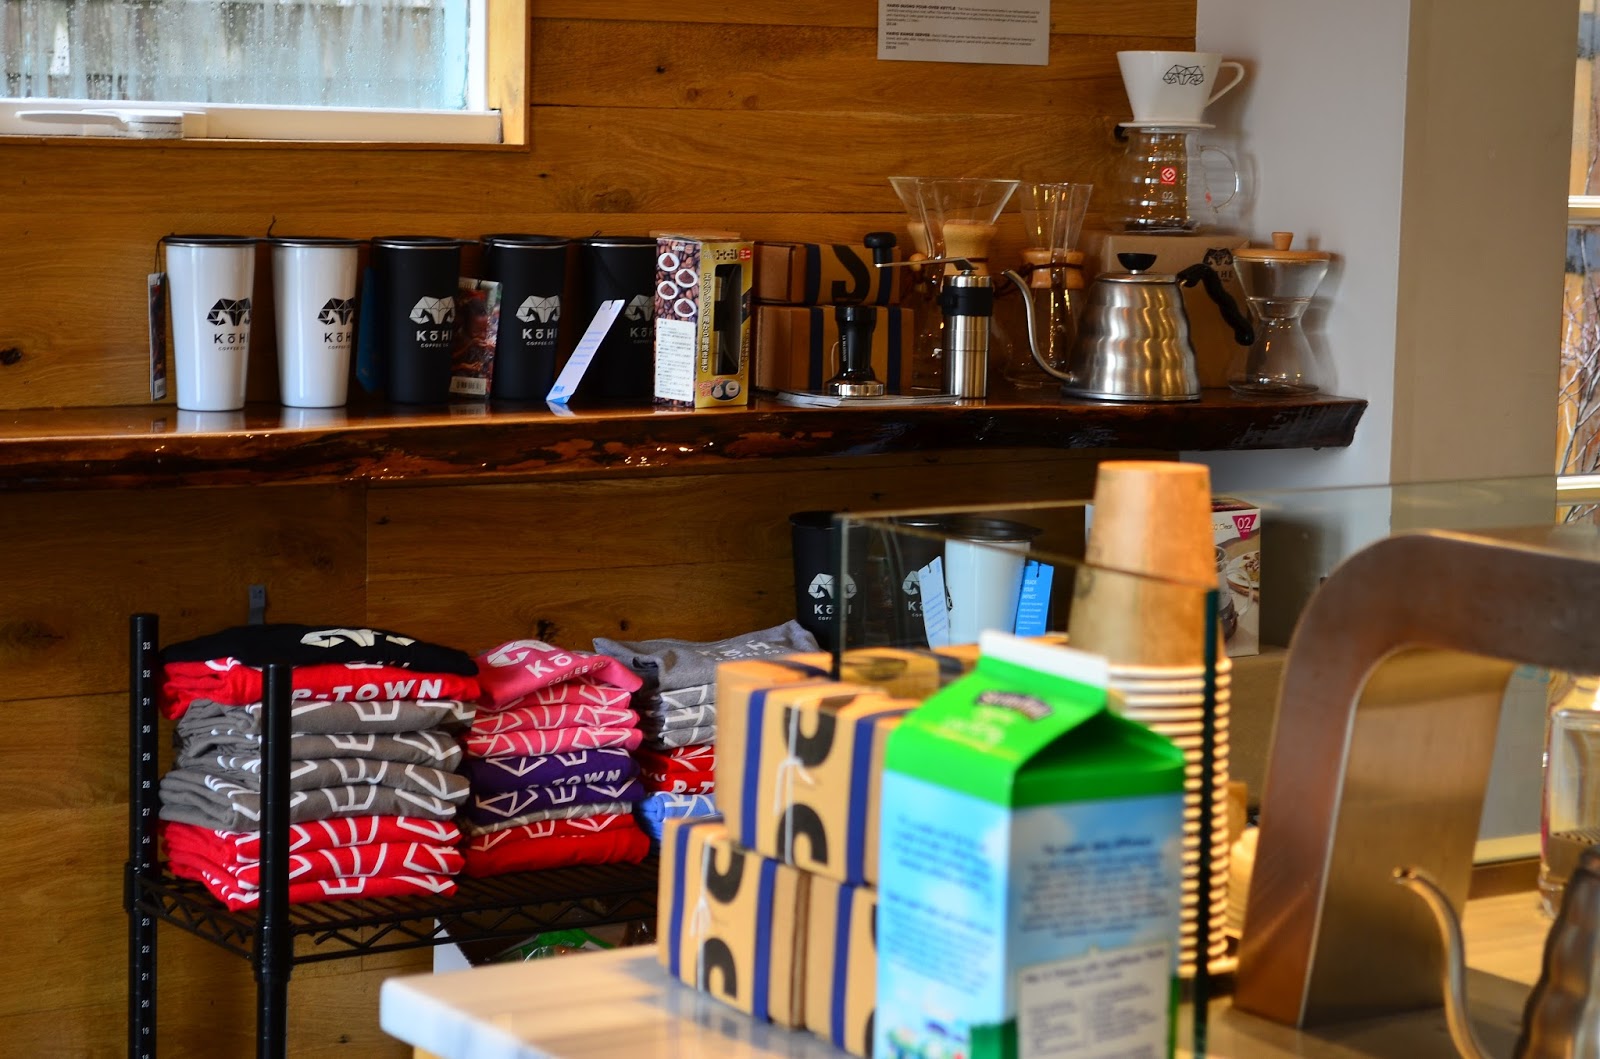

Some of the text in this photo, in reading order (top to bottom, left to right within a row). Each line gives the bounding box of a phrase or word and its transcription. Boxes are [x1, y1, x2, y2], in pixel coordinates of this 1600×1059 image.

[1237, 517, 1251, 529] 02
[143, 642, 151, 650] 33
[143, 670, 151, 678] 32
[548, 665, 589, 686] COFFEE
[292, 679, 442, 702] P-TOWN
[143, 698, 150, 706] 31
[143, 725, 151, 733] 30
[142, 753, 151, 761] 29
[142, 781, 151, 789] 28
[142, 808, 150, 816] 27
[141, 918, 150, 926] 23
[141, 945, 150, 953] 22
[141, 973, 149, 981] 21
[141, 1000, 150, 1008] 20
[141, 1027, 150, 1035] 19
